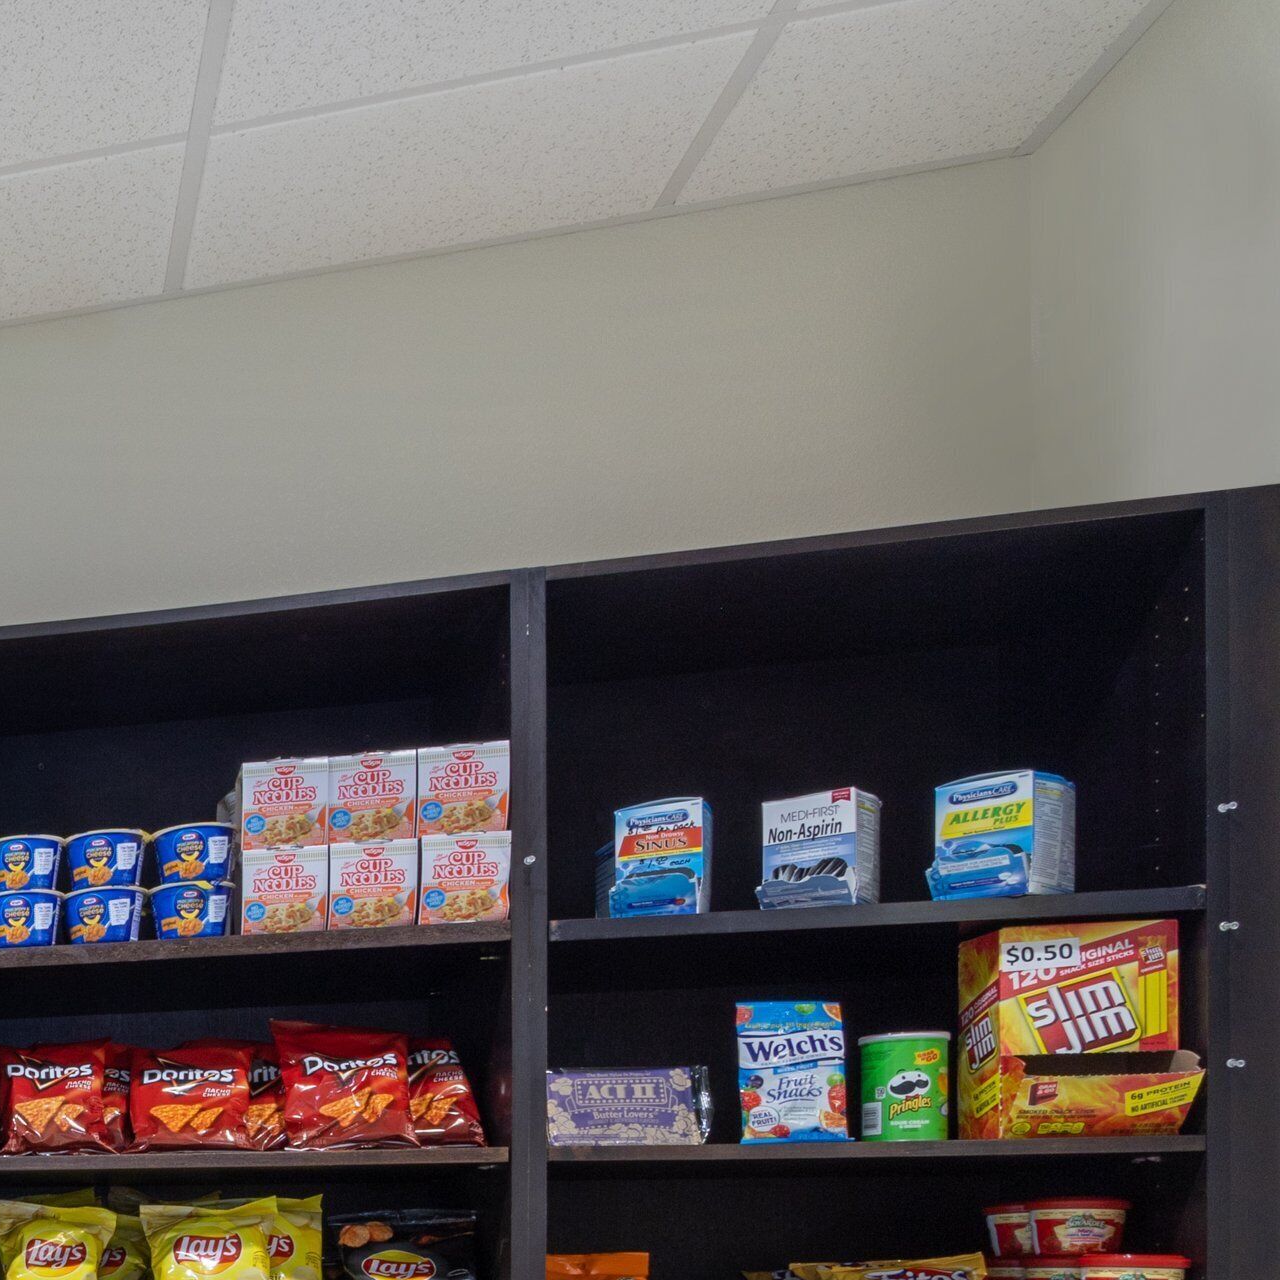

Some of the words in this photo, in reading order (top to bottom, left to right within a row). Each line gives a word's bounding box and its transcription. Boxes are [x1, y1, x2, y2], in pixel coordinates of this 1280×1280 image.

[445, 761, 484, 777] CUP
[267, 776, 304, 792] CUP
[429, 771, 497, 792] NOODLES
[253, 790, 317, 806] NOODLES
[780, 805, 840, 823] MEDI-FIRST
[949, 802, 1026, 825] ALLERGY
[993, 815, 1019, 825] PLUS
[768, 819, 843, 844] Non-Aspirin
[635, 838, 687, 853] SINUS
[1006, 943, 1073, 965] $0.50
[1059, 963, 1087, 977] SNACK
[1087, 959, 1105, 970] SIZE
[1106, 949, 1135, 963] STICKS
[1008, 967, 1057, 990] 120
[743, 1034, 843, 1063] Welch's
[6, 1063, 93, 1080] Doritos
[303, 1053, 399, 1076] Doritos
[142, 1068, 235, 1086] Doritos
[778, 1074, 817, 1091] Fruit
[586, 1084, 627, 1099] ACT
[631, 1083, 656, 1099] II
[766, 1086, 823, 1104] Snacks
[1146, 1081, 1191, 1097] PROTEIN
[593, 1109, 622, 1120] Butter
[624, 1109, 654, 1119] Lovers
[753, 1111, 773, 1119] REAL
[888, 1095, 933, 1121] Pringles
[752, 1117, 777, 1127] FRUIT!
[28, 1240, 84, 1269] Lay's
[177, 1232, 240, 1270] Lay's
[369, 1259, 431, 1280] Lay's
